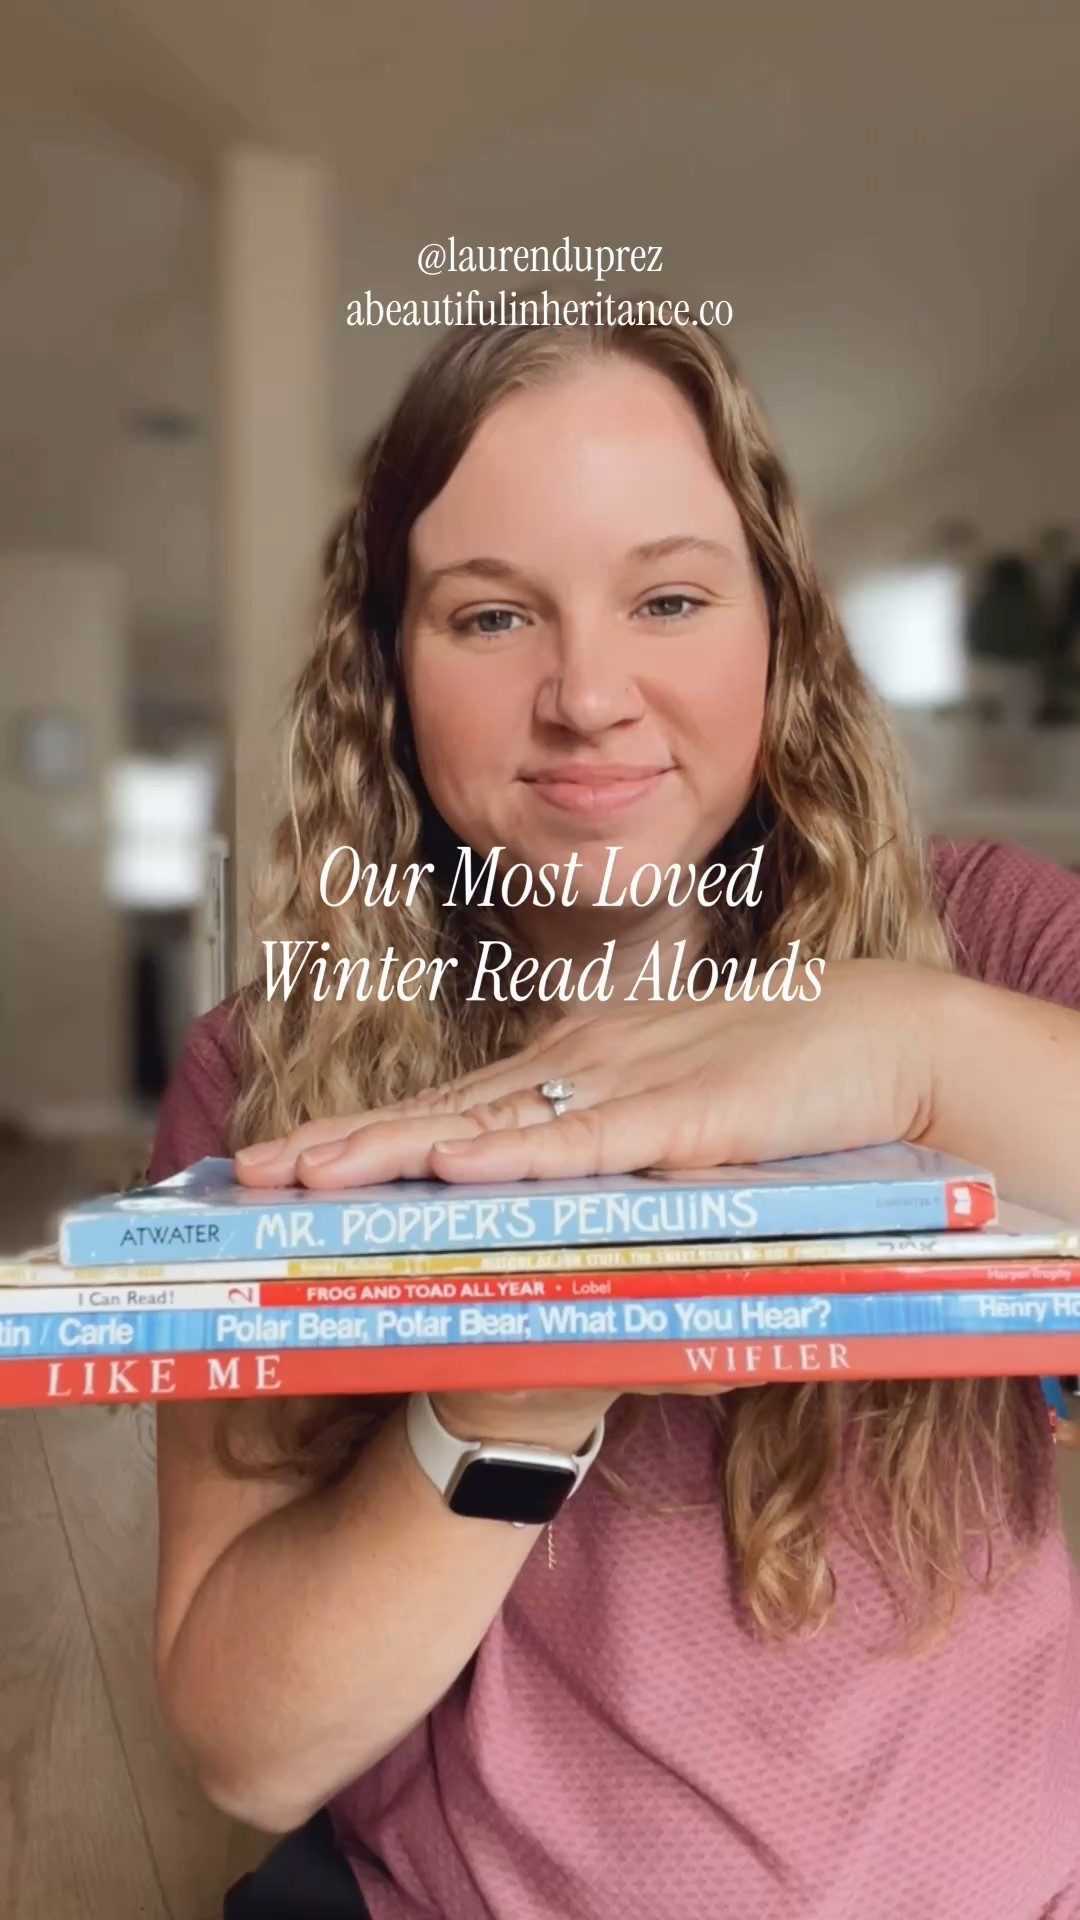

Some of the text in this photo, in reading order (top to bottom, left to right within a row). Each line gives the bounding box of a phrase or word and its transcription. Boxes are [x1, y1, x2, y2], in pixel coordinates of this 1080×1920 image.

[120, 1223, 220, 1246] ATWATER
[254, 1210, 325, 1249] MR.
[342, 1199, 536, 1246] POPPER'S
[78, 1291, 174, 1306] I Can Read!
[227, 1286, 253, 1304] 2
[306, 1281, 545, 1301] FROG AND TOAD ALL YEAR
[571, 1279, 612, 1295] Lobel
[216, 1297, 832, 1342] Polar Bear, Polar Bear, What Do You Hear?
[979, 1296, 1048, 1324] Henry
[58, 1319, 135, 1346] Carle
[684, 1343, 850, 1373] WIFLER
[47, 1354, 282, 1397] LIKE ME
